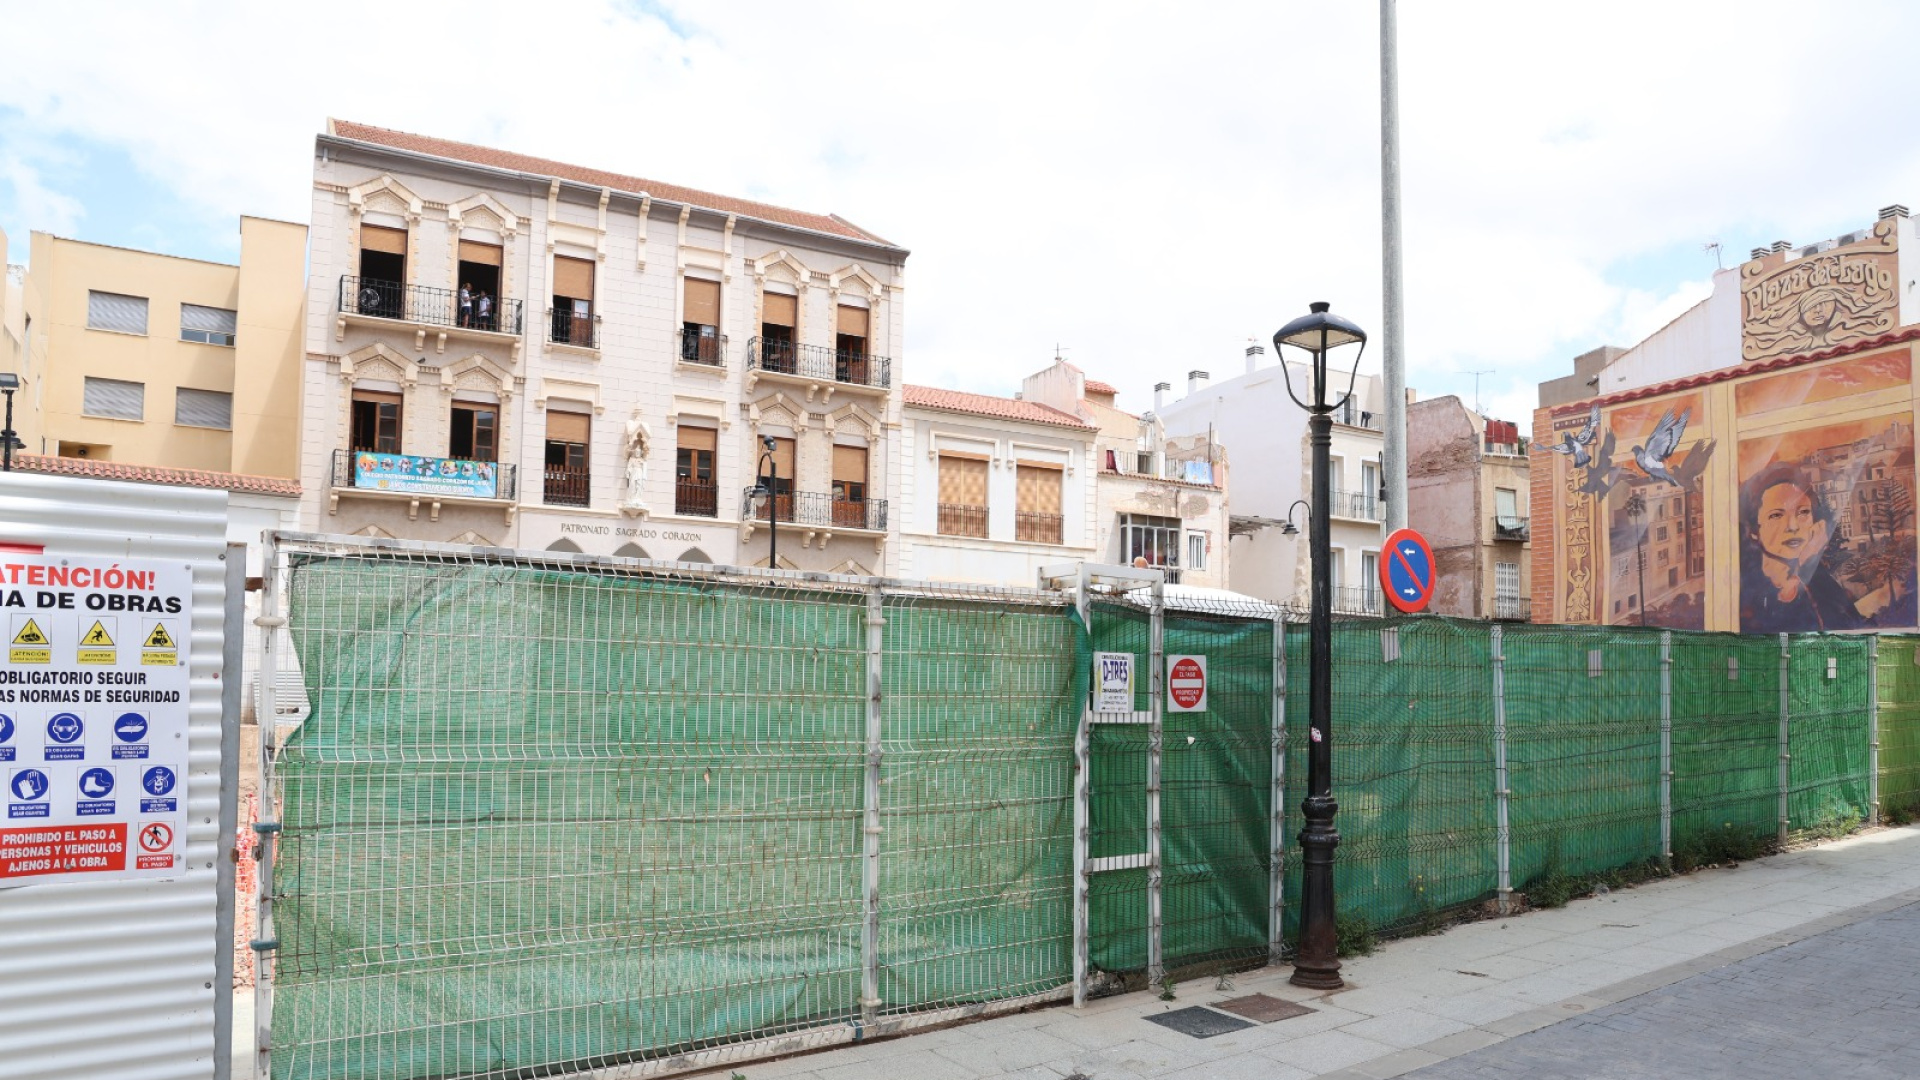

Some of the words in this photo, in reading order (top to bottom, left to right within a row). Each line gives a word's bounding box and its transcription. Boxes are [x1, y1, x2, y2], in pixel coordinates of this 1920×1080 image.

[561, 523, 610, 535] PATRONATO
[615, 527, 657, 539] SAGRADO
[662, 531, 702, 542] CORAZON
[36, 591, 75, 609] DE
[85, 593, 182, 613] OBRAS
[0, 671, 93, 685] OBLIGATORIO
[97, 671, 147, 685] SEGUIR
[19, 690, 80, 703] NORMAS
[84, 690, 102, 703] DE
[106, 690, 180, 703] SEGURIDAD
[2, 832, 62, 845] PROHIBIDO
[64, 831, 77, 841] EL
[79, 830, 106, 841] PASO
[109, 829, 116, 839] A
[54, 845, 62, 855] Y
[64, 842, 122, 855] VEHICULOS
[8, 859, 51, 872] AJENOS
[53, 859, 61, 869] A
[79, 856, 108, 868] OBRA
